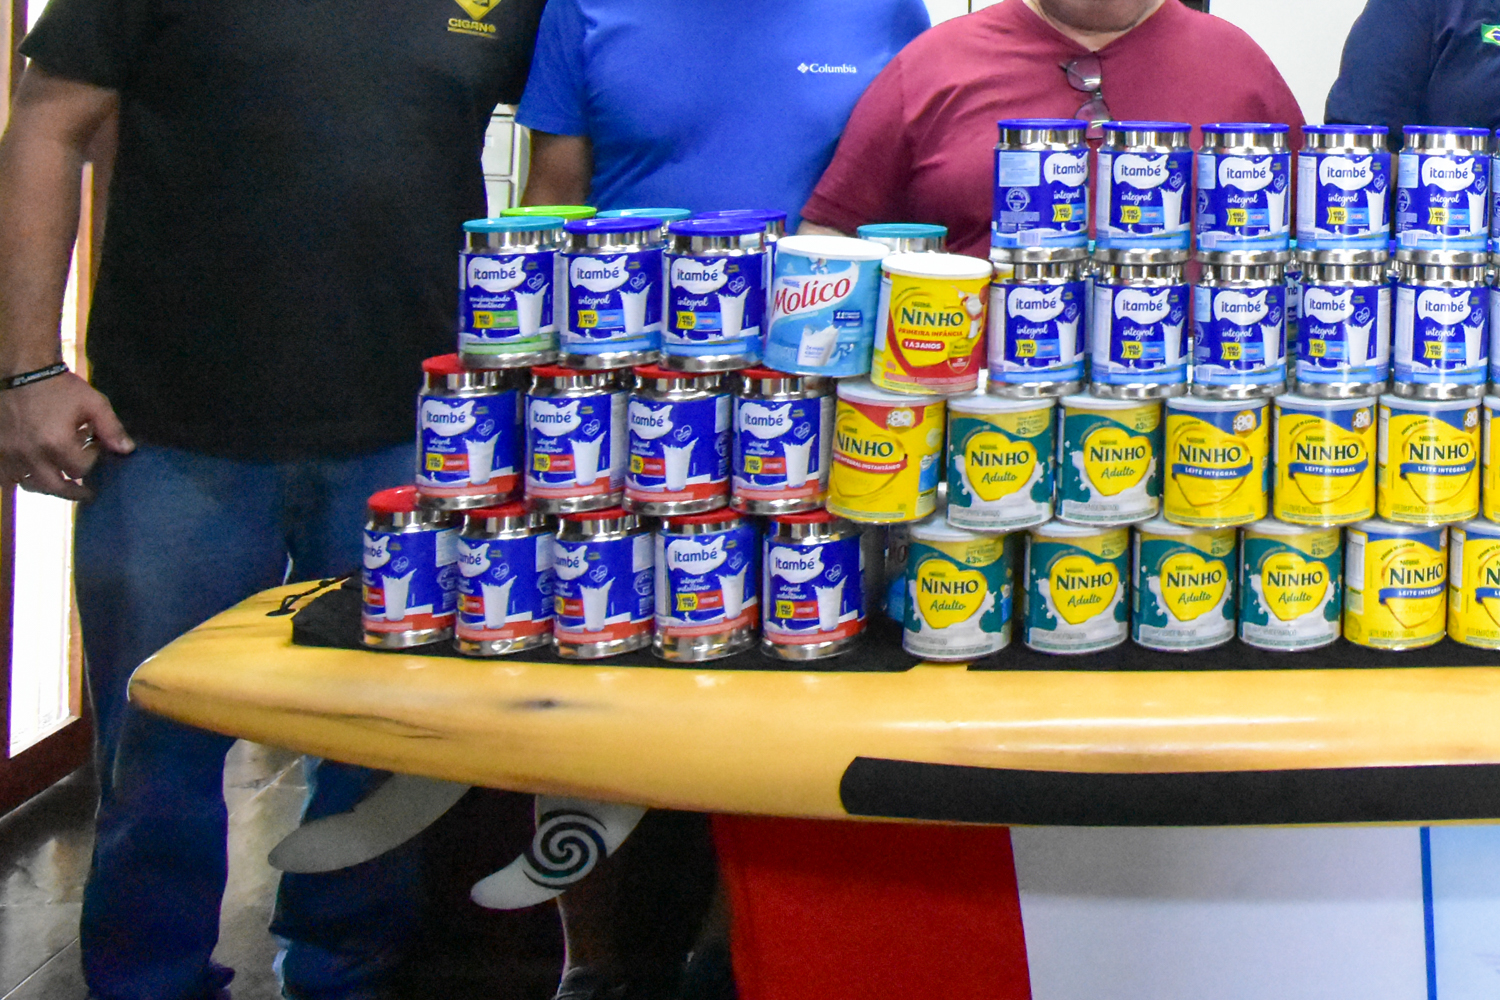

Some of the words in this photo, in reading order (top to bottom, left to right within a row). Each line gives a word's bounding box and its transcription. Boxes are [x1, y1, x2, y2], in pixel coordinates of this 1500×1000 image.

[809, 63, 857, 74] Columbia
[1120, 164, 1161, 179] itambé
[1226, 166, 1266, 181] itambé
[1327, 166, 1366, 180] itambé
[1430, 166, 1469, 181] itambé
[474, 266, 517, 281] itambé
[577, 266, 620, 281] itambé
[677, 267, 718, 282] itambé
[772, 278, 851, 318] Molico
[1015, 297, 1057, 311] itambé
[1122, 298, 1163, 312] itambé
[1222, 298, 1261, 313] itambé
[1309, 297, 1346, 312] itambé
[1425, 300, 1465, 314] itambé
[901, 307, 964, 326] NINHO
[898, 328, 930, 336] PRIMEIRA
[426, 409, 466, 424] itambé
[532, 410, 572, 426] itambé
[743, 412, 784, 427] itambé
[836, 431, 894, 457] NINHO
[1296, 442, 1359, 461] NINHO
[1408, 442, 1469, 461] NINHO
[970, 450, 1030, 468] NINHO
[1088, 445, 1147, 462] NINHO
[1178, 445, 1241, 464] NINHO
[981, 471, 1018, 484] Adulto
[1100, 466, 1136, 479] Adulto
[1185, 466, 1203, 475] LEITE
[673, 546, 718, 563] itambé
[774, 556, 816, 572] itambé
[1055, 572, 1113, 591] NINHO
[1166, 569, 1223, 588] NINHO
[1266, 570, 1324, 588] NINHO
[1389, 562, 1444, 586] NINHO
[921, 577, 979, 595] NINHO
[1067, 594, 1102, 607] Adulto
[1178, 591, 1212, 604] Adulto
[1278, 591, 1312, 603] Adulto
[929, 600, 966, 612] Adulto
